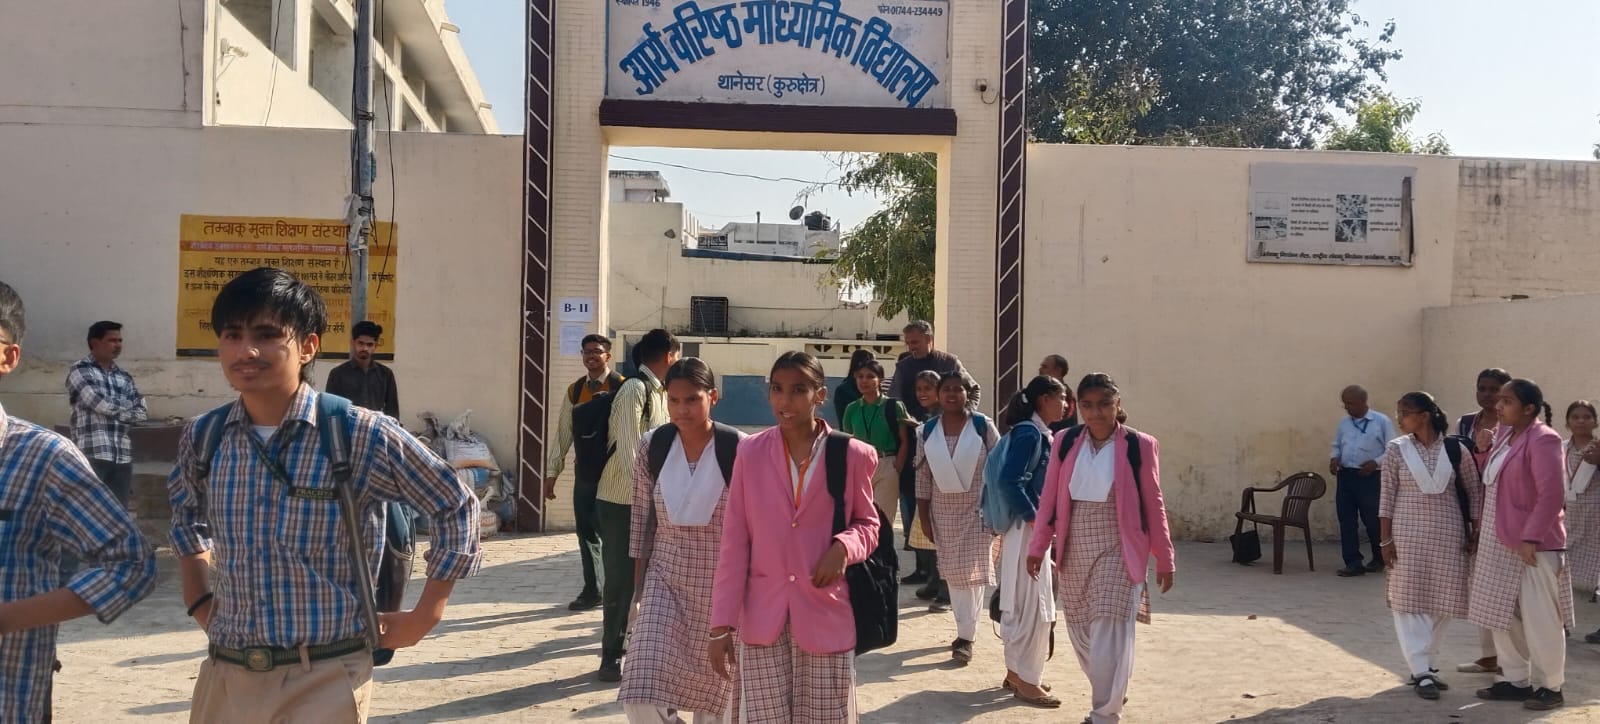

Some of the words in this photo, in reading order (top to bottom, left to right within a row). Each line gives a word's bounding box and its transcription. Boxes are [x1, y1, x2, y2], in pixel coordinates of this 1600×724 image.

[619, 22, 680, 96] आर्य
[662, 4, 742, 64] वरिष्ठ
[743, 0, 863, 59] माध्यमिक
[851, 16, 940, 109] विद्यालय
[717, 69, 765, 92] थानेसर
[248, 223, 273, 239] मुक्त
[276, 219, 307, 238] शिक्षण
